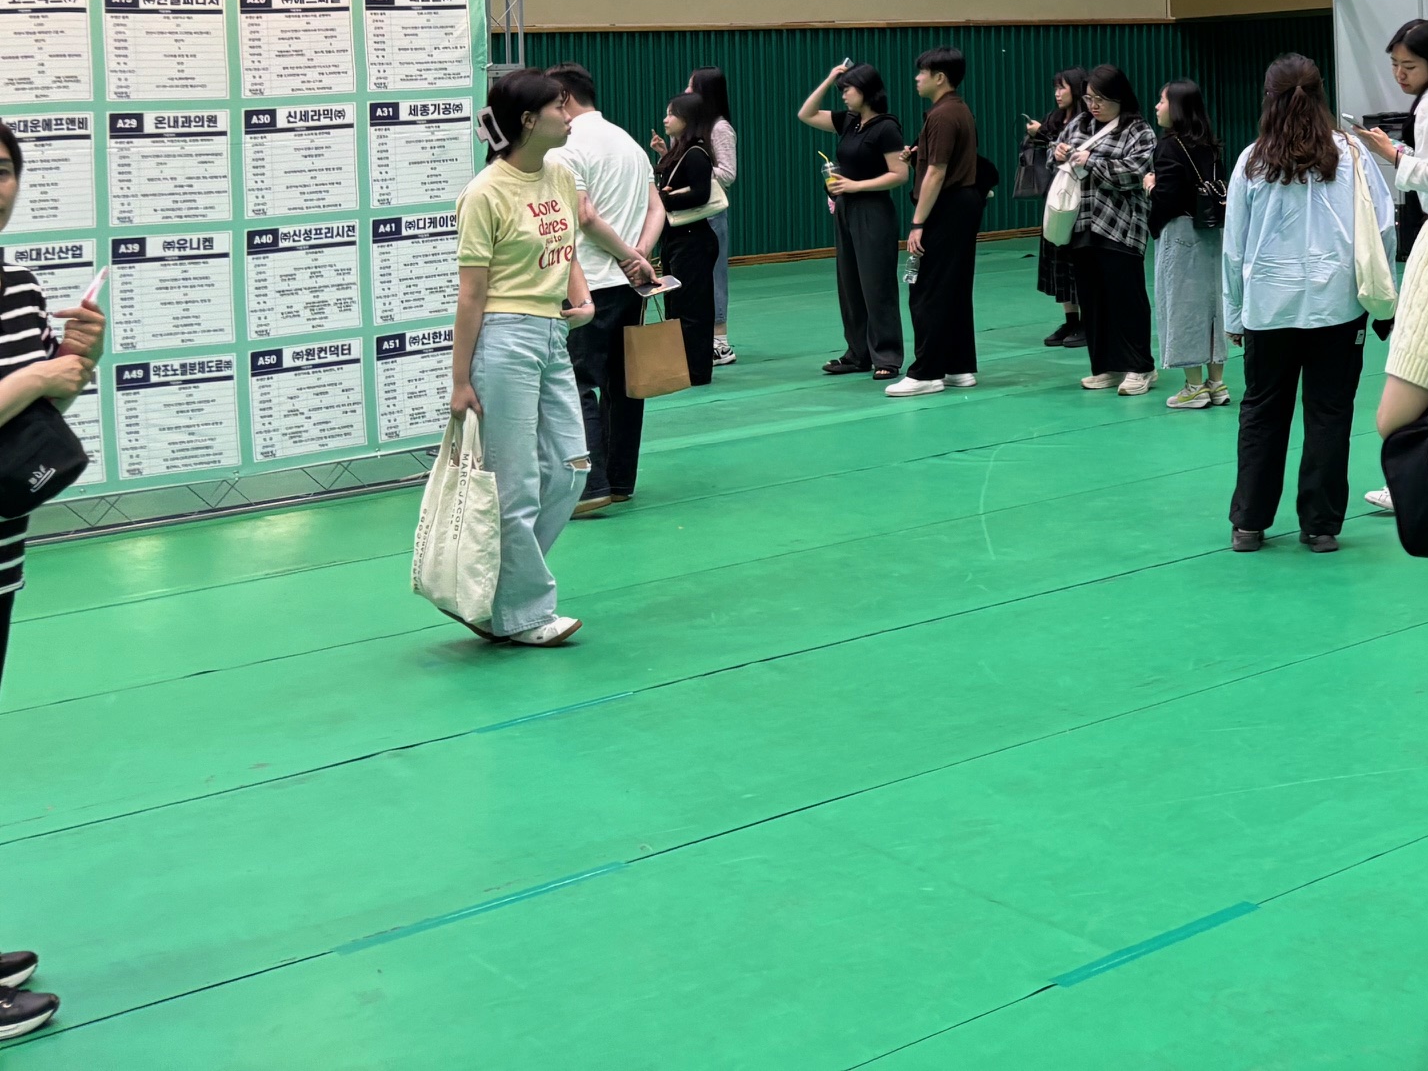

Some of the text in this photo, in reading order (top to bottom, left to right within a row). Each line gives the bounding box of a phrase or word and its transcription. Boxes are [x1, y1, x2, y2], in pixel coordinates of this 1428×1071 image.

[376, 107, 393, 117] A31
[116, 119, 138, 129] A29
[154, 115, 218, 129] 온내과의원
[251, 114, 270, 124] A30
[526, 198, 560, 219] Love
[378, 223, 396, 233] A41
[538, 217, 568, 237] dares
[254, 234, 273, 245] A40
[118, 244, 140, 253] A39
[538, 243, 574, 271] Care
[382, 341, 400, 351] A51
[258, 355, 277, 365] A50
[123, 369, 144, 379] A49
[461, 453, 470, 487] MARC
[452, 491, 465, 540] JACOBS
